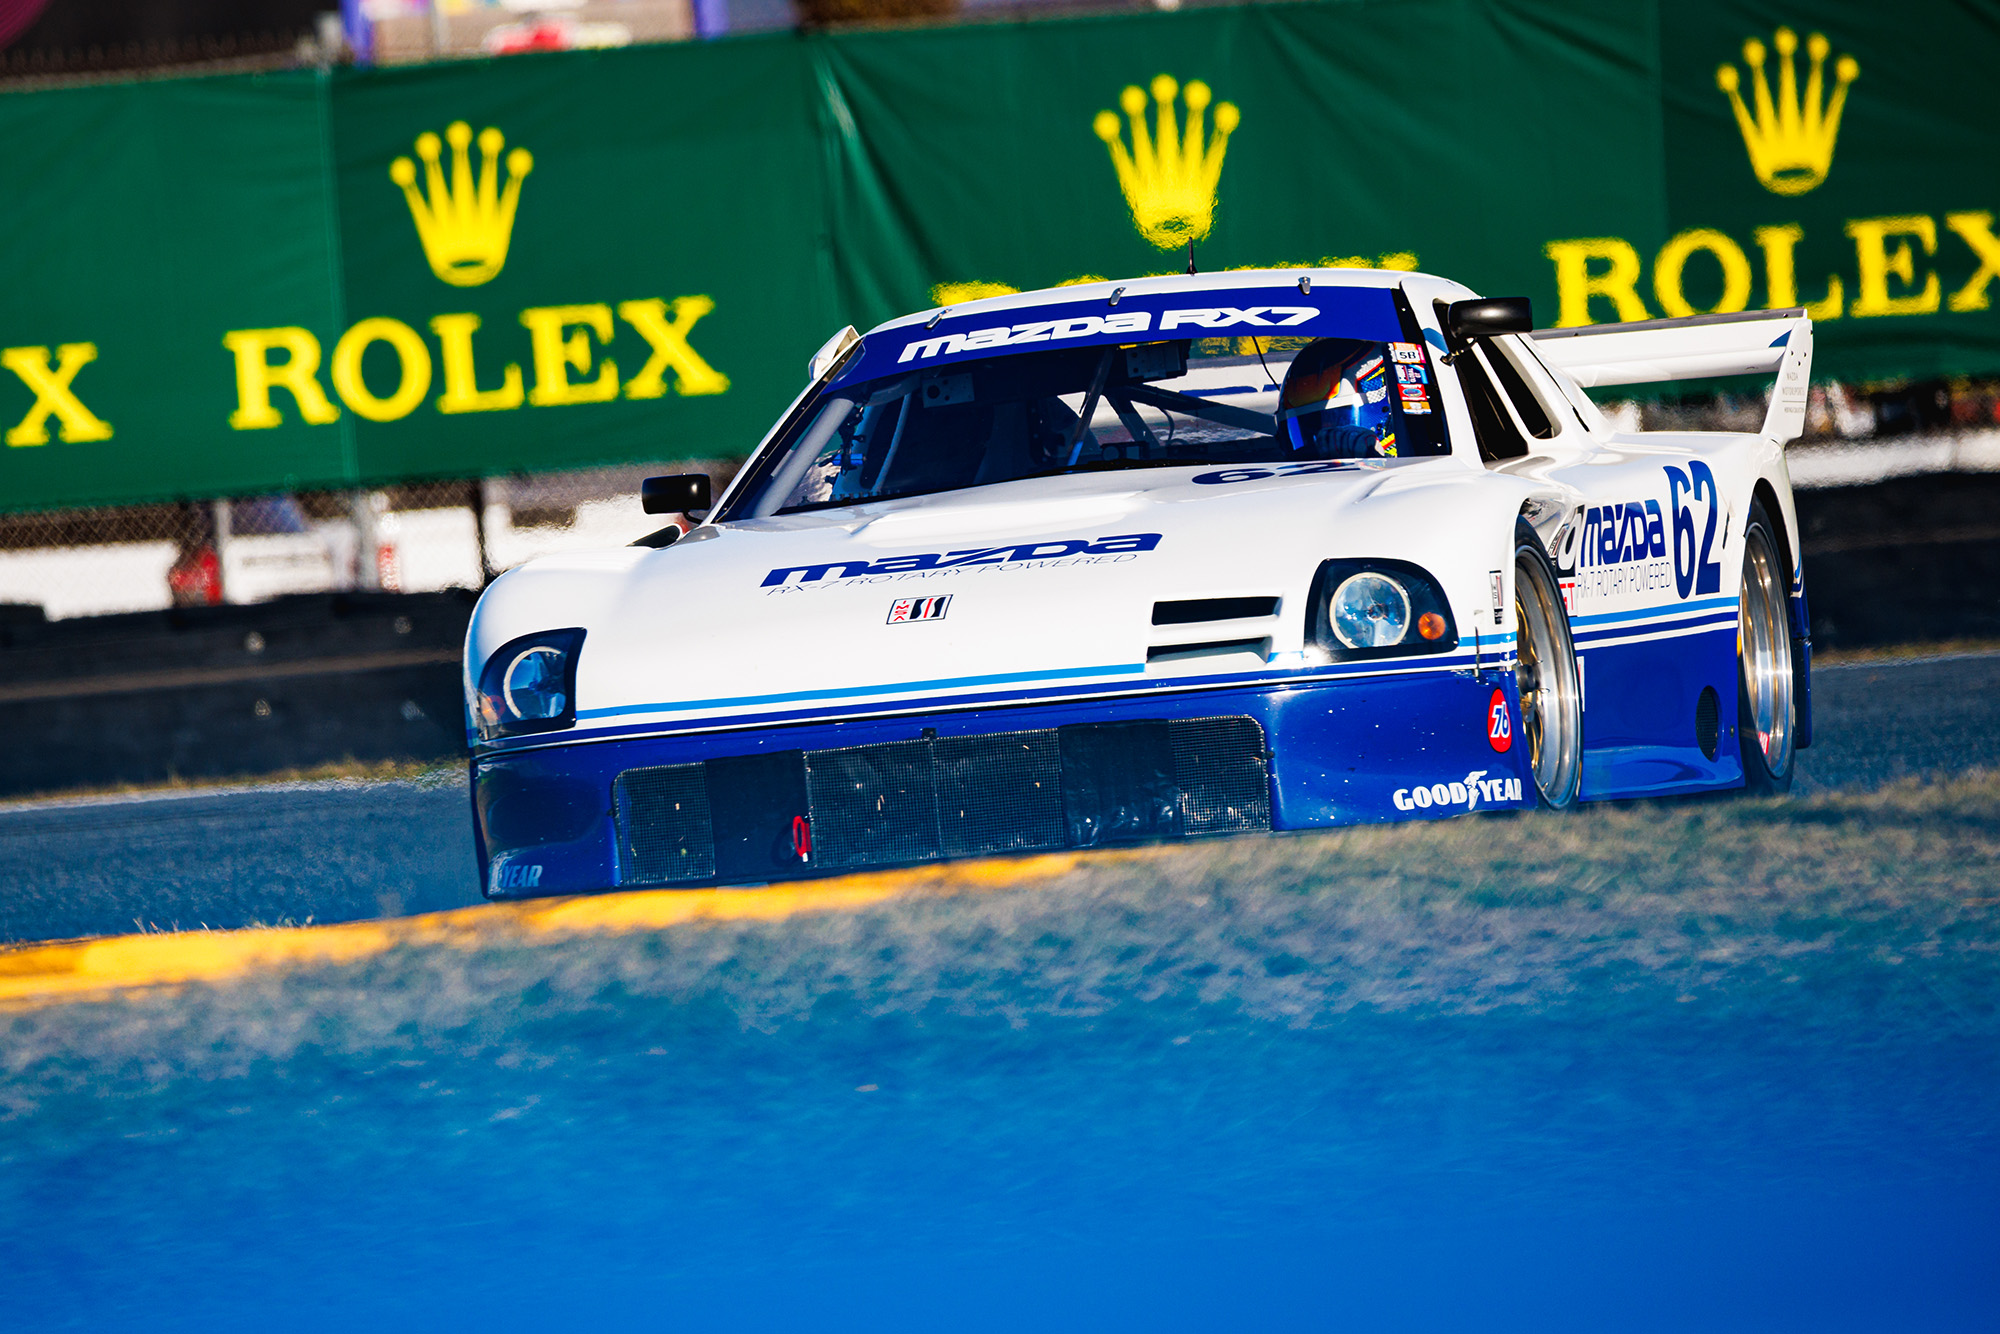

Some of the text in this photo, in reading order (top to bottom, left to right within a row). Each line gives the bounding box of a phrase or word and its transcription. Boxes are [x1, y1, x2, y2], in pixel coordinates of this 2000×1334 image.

[897, 306, 1320, 364] mazda RX7
[222, 294, 731, 431] ROLEX
[0, 341, 114, 448] X
[1191, 461, 1361, 485] 62
[1580, 499, 1666, 567] mazda
[1662, 460, 1721, 599] 62
[760, 533, 1163, 587] mazda
[767, 553, 1137, 596] RX-7 ROTARY POWERED
[1576, 561, 1672, 598] RX-7 ROTARY POWERED
[1490, 701, 1510, 738] 76
[1393, 777, 1522, 811] GOODYEAR
